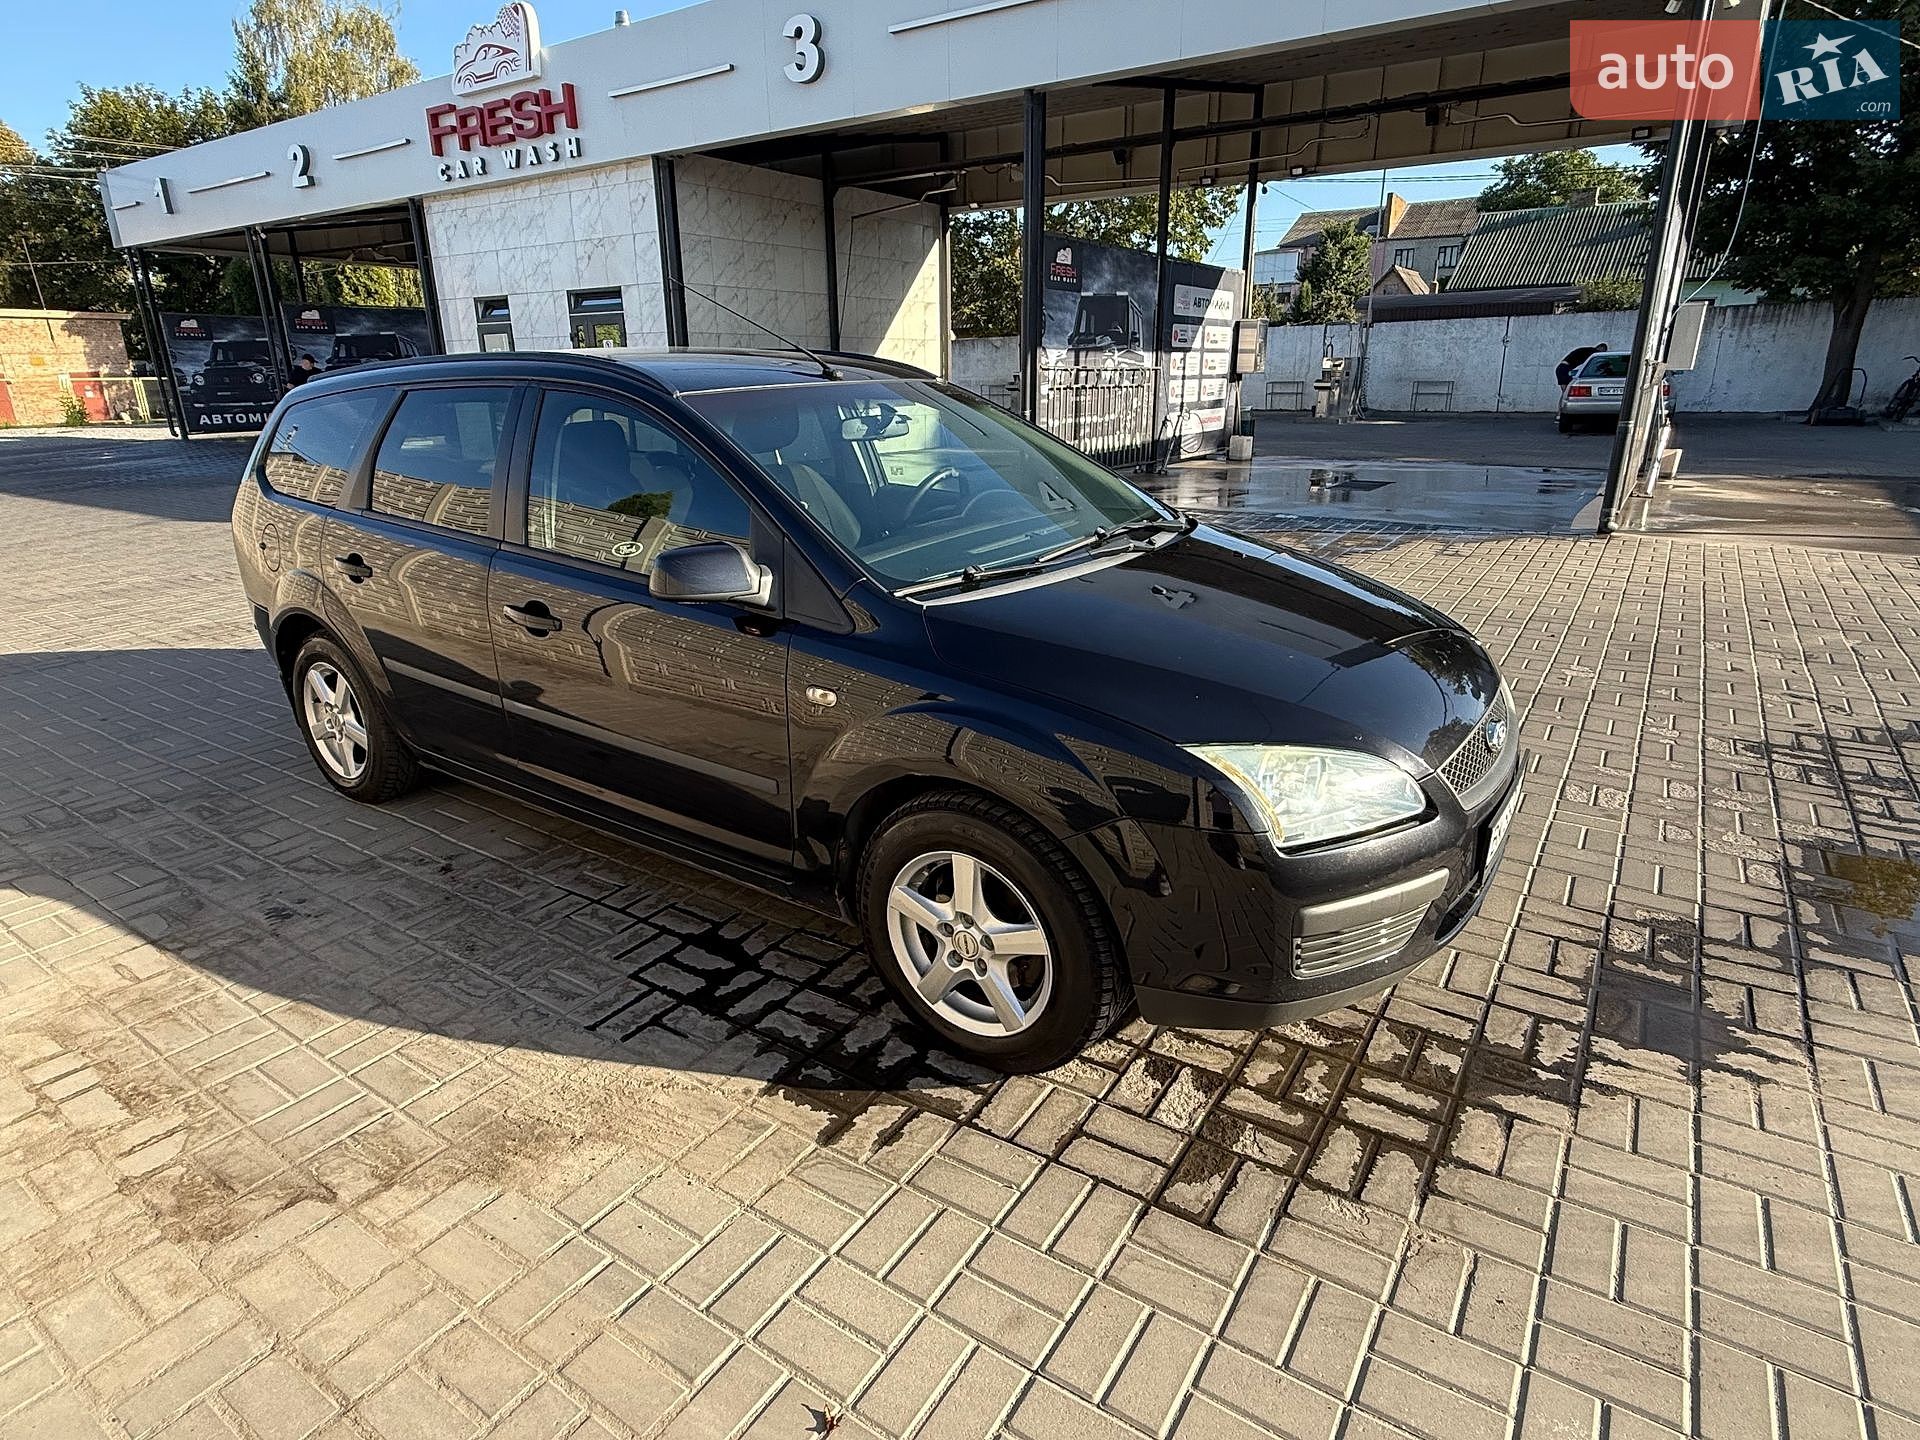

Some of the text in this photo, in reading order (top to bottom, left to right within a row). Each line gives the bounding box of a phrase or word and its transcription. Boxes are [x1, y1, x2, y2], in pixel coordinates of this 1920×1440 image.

[782, 13, 826, 84] 3
[425, 82, 579, 157] FRESH
[287, 143, 316, 189] 2
[437, 136, 582, 182] CAR WASH
[154, 177, 175, 215] 1
[1050, 262, 1077, 277] FRESH
